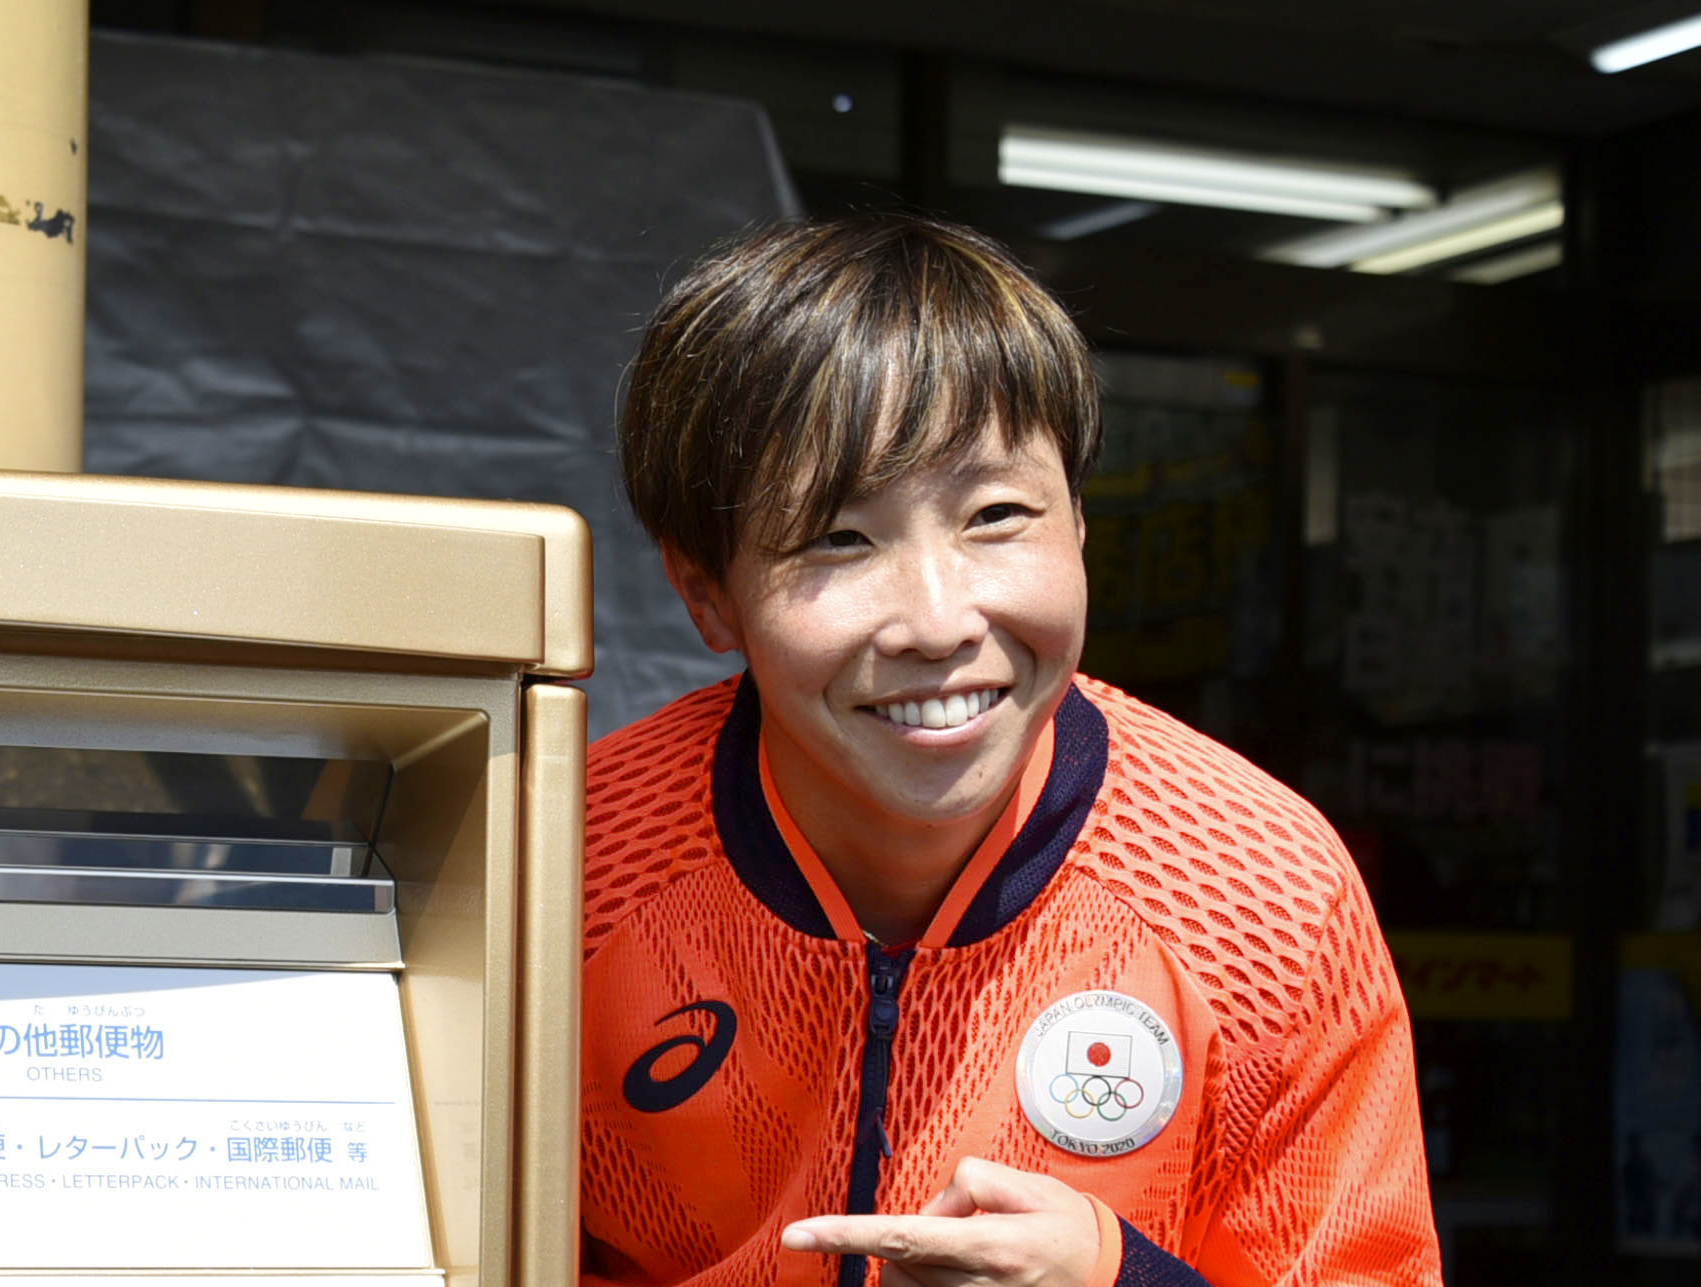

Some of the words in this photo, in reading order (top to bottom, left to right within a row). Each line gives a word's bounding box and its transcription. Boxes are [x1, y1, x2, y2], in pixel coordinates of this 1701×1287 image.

[1032, 1001, 1071, 1037] JAPAN
[1073, 994, 1136, 1016] OLYMPIC
[1138, 1009, 1170, 1046] TEAM
[26, 1066, 103, 1083] OTHERS
[347, 1141, 368, 1164] 等
[1049, 1129, 1099, 1155] TOKYO
[1102, 1137, 1136, 1155] 2020
[61, 1174, 180, 1190] LETTERPACK
[195, 1175, 335, 1191] INTERNATIONAL
[339, 1176, 380, 1192] MAIL
